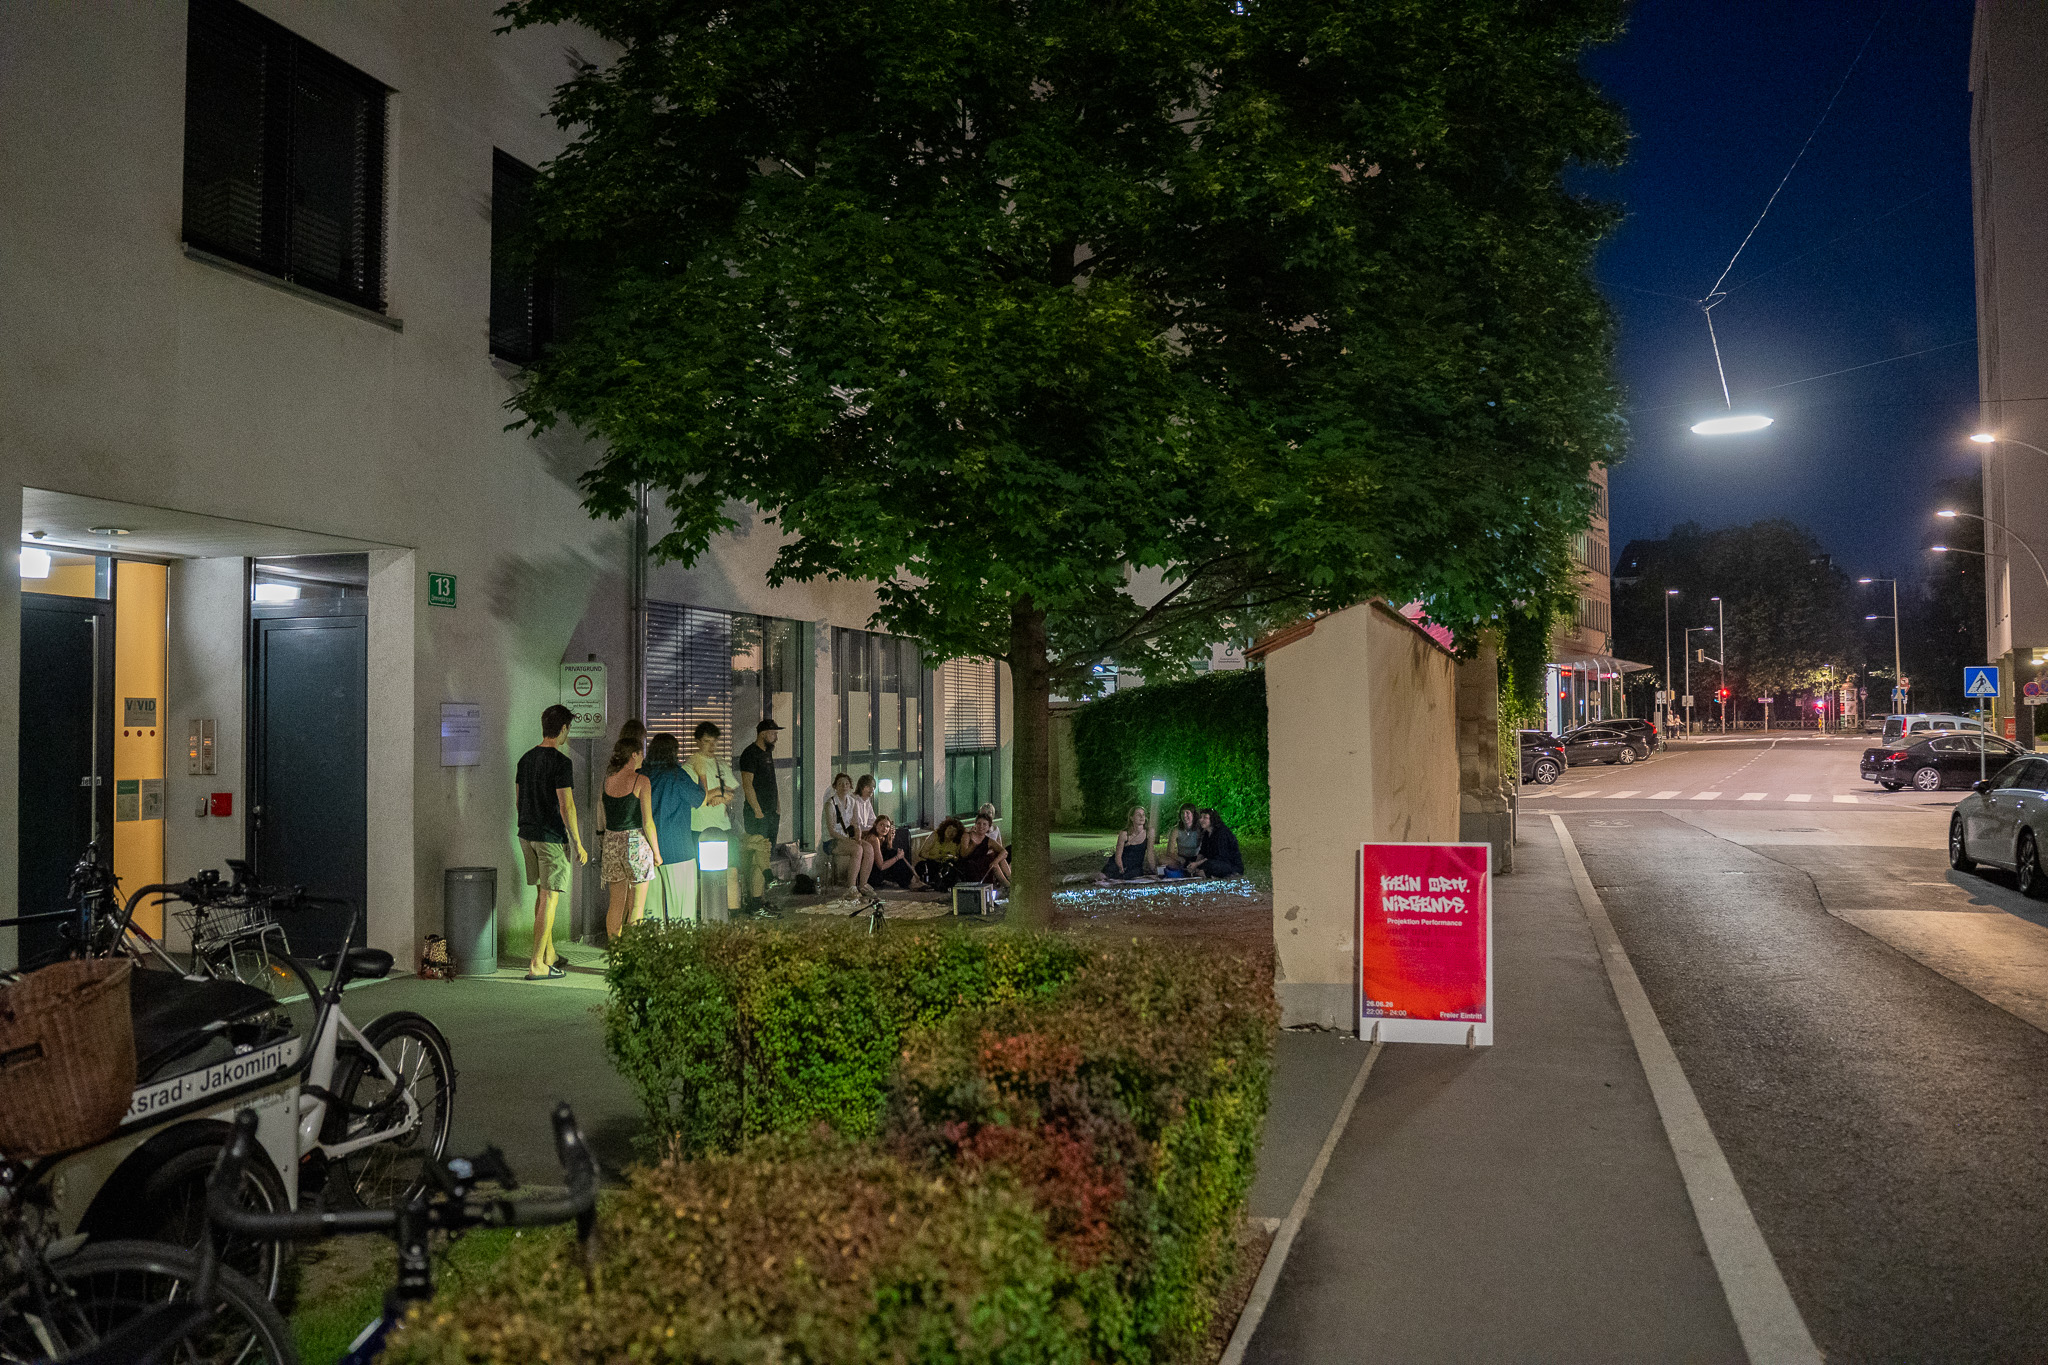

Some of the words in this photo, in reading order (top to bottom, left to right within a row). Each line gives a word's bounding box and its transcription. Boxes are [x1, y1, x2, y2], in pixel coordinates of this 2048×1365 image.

[435, 577, 451, 597] 13
[1380, 874, 1421, 892] KEIN
[1428, 875, 1471, 893] ORT.
[1382, 894, 1469, 914] NIRGENDS.
[1387, 918, 1420, 926] Projektion
[1389, 1008, 1407, 1016] 24:00
[1439, 1011, 1460, 1019] Freier
[1460, 1012, 1483, 1020] Eintritt
[200, 1046, 284, 1092] Jakomini
